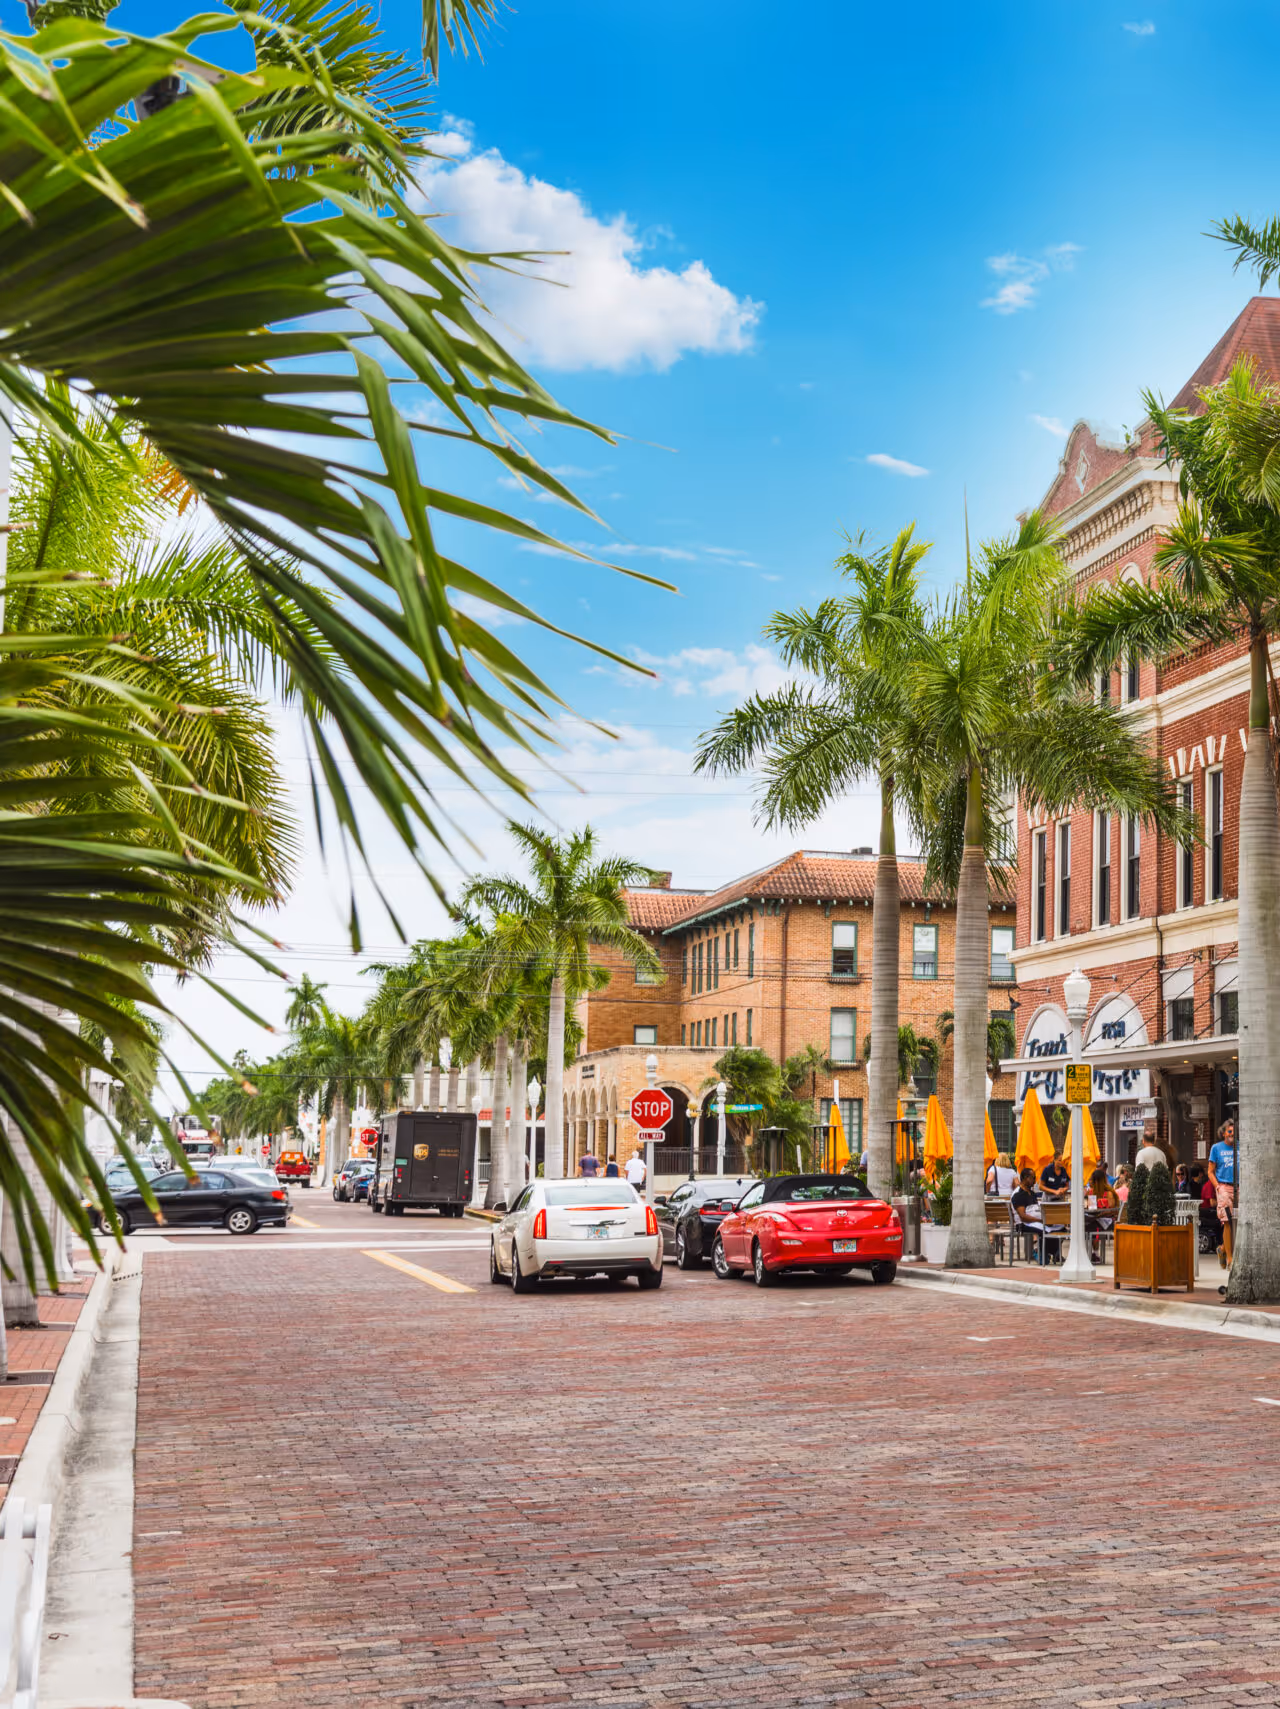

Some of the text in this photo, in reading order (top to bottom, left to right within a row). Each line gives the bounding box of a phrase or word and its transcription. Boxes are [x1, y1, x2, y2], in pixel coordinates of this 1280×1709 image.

[1068, 1066, 1075, 1078] 2
[633, 1101, 670, 1117] STOP
[651, 1132, 663, 1140] WAY
